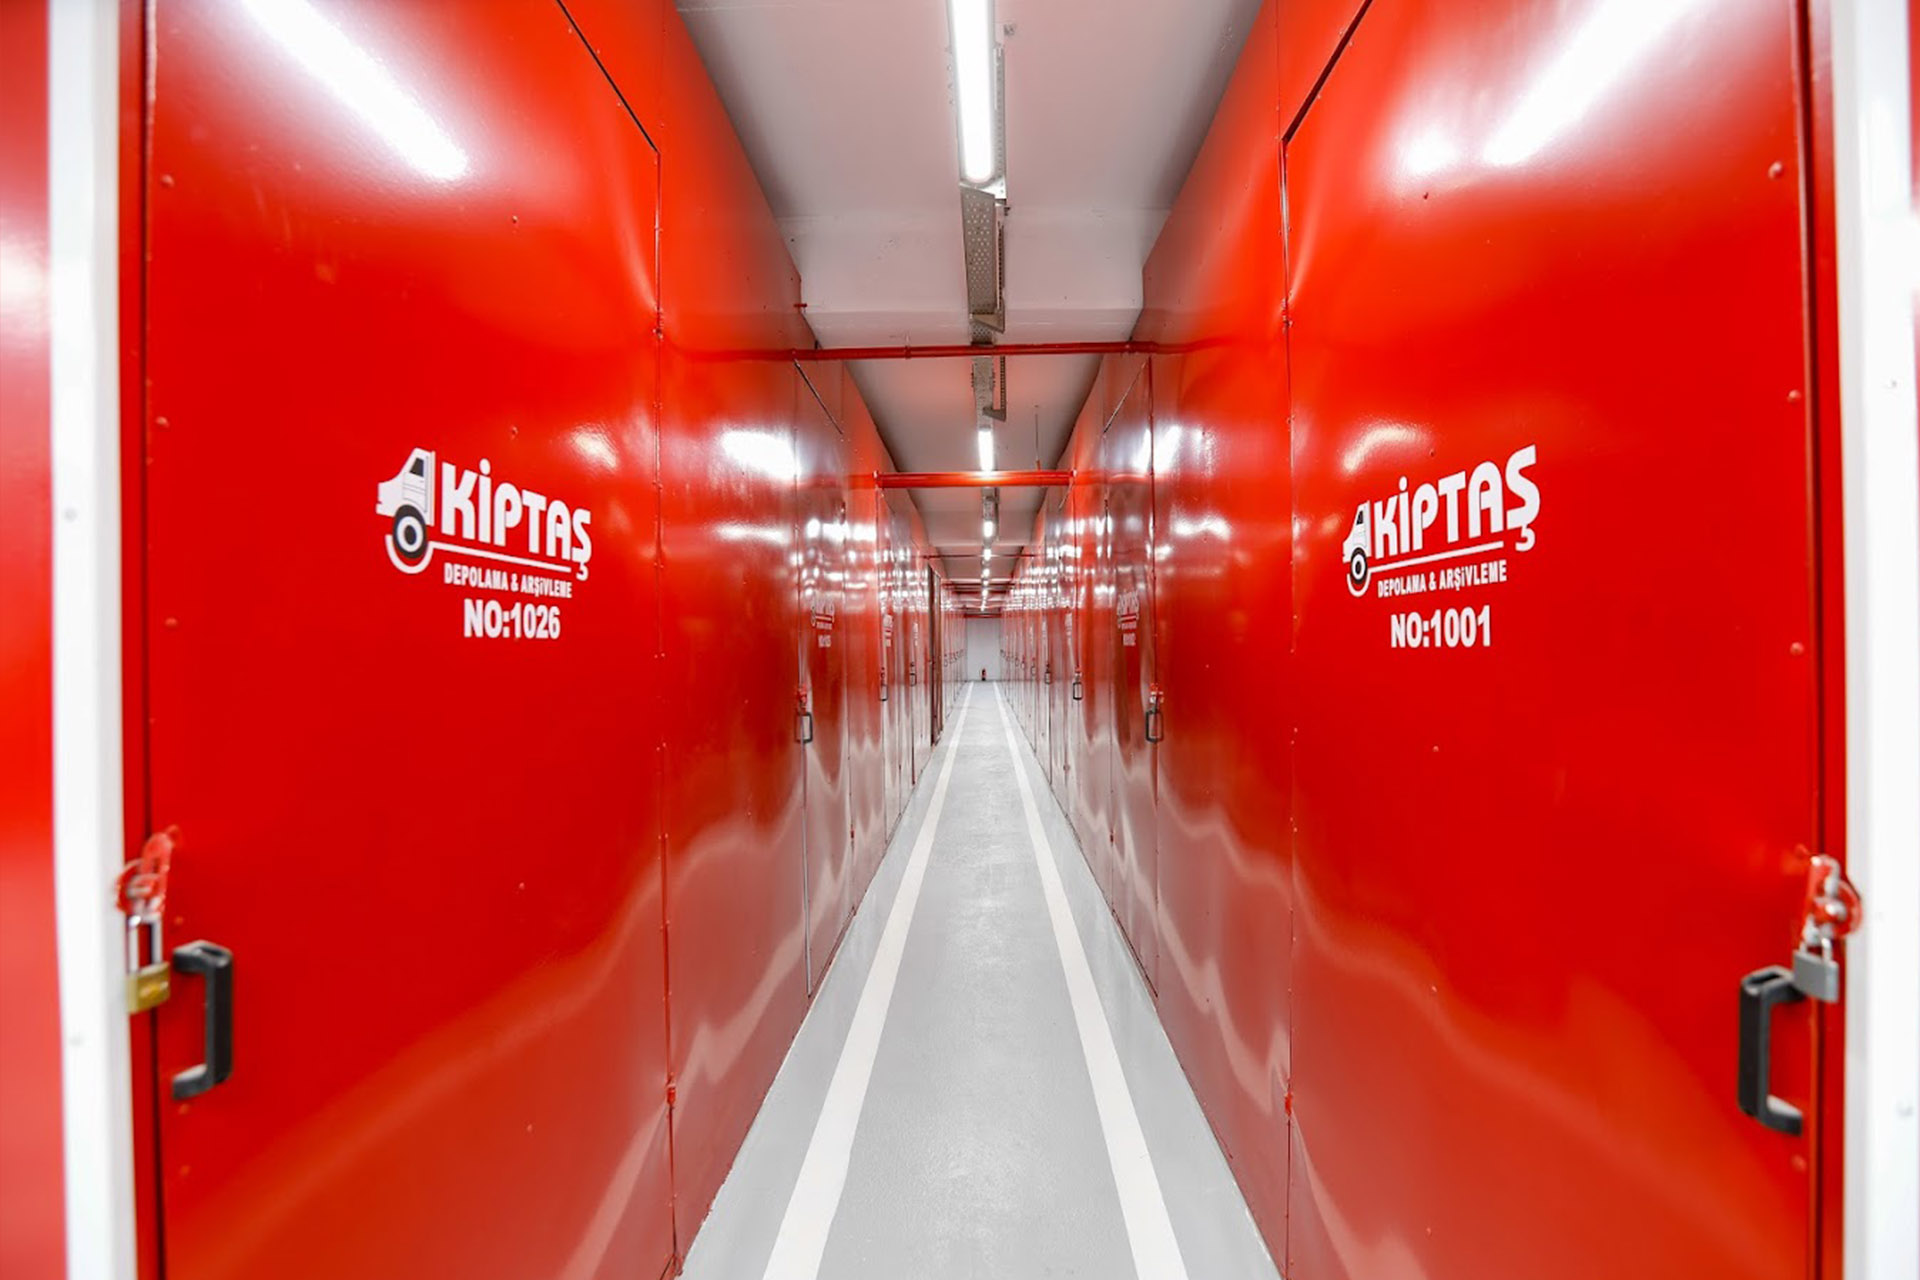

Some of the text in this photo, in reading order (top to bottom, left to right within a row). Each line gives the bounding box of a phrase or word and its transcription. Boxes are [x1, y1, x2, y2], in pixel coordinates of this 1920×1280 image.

[1373, 444, 1540, 552] KİPTAŞ
[441, 458, 592, 581] KİPTAŞ
[444, 562, 509, 591] DEPOLAMA
[510, 573, 519, 592] &
[1377, 573, 1427, 598] DEPOLAMA
[1428, 571, 1437, 591] &
[463, 598, 561, 639] NO:1026
[1390, 604, 1491, 648] NO:1001
